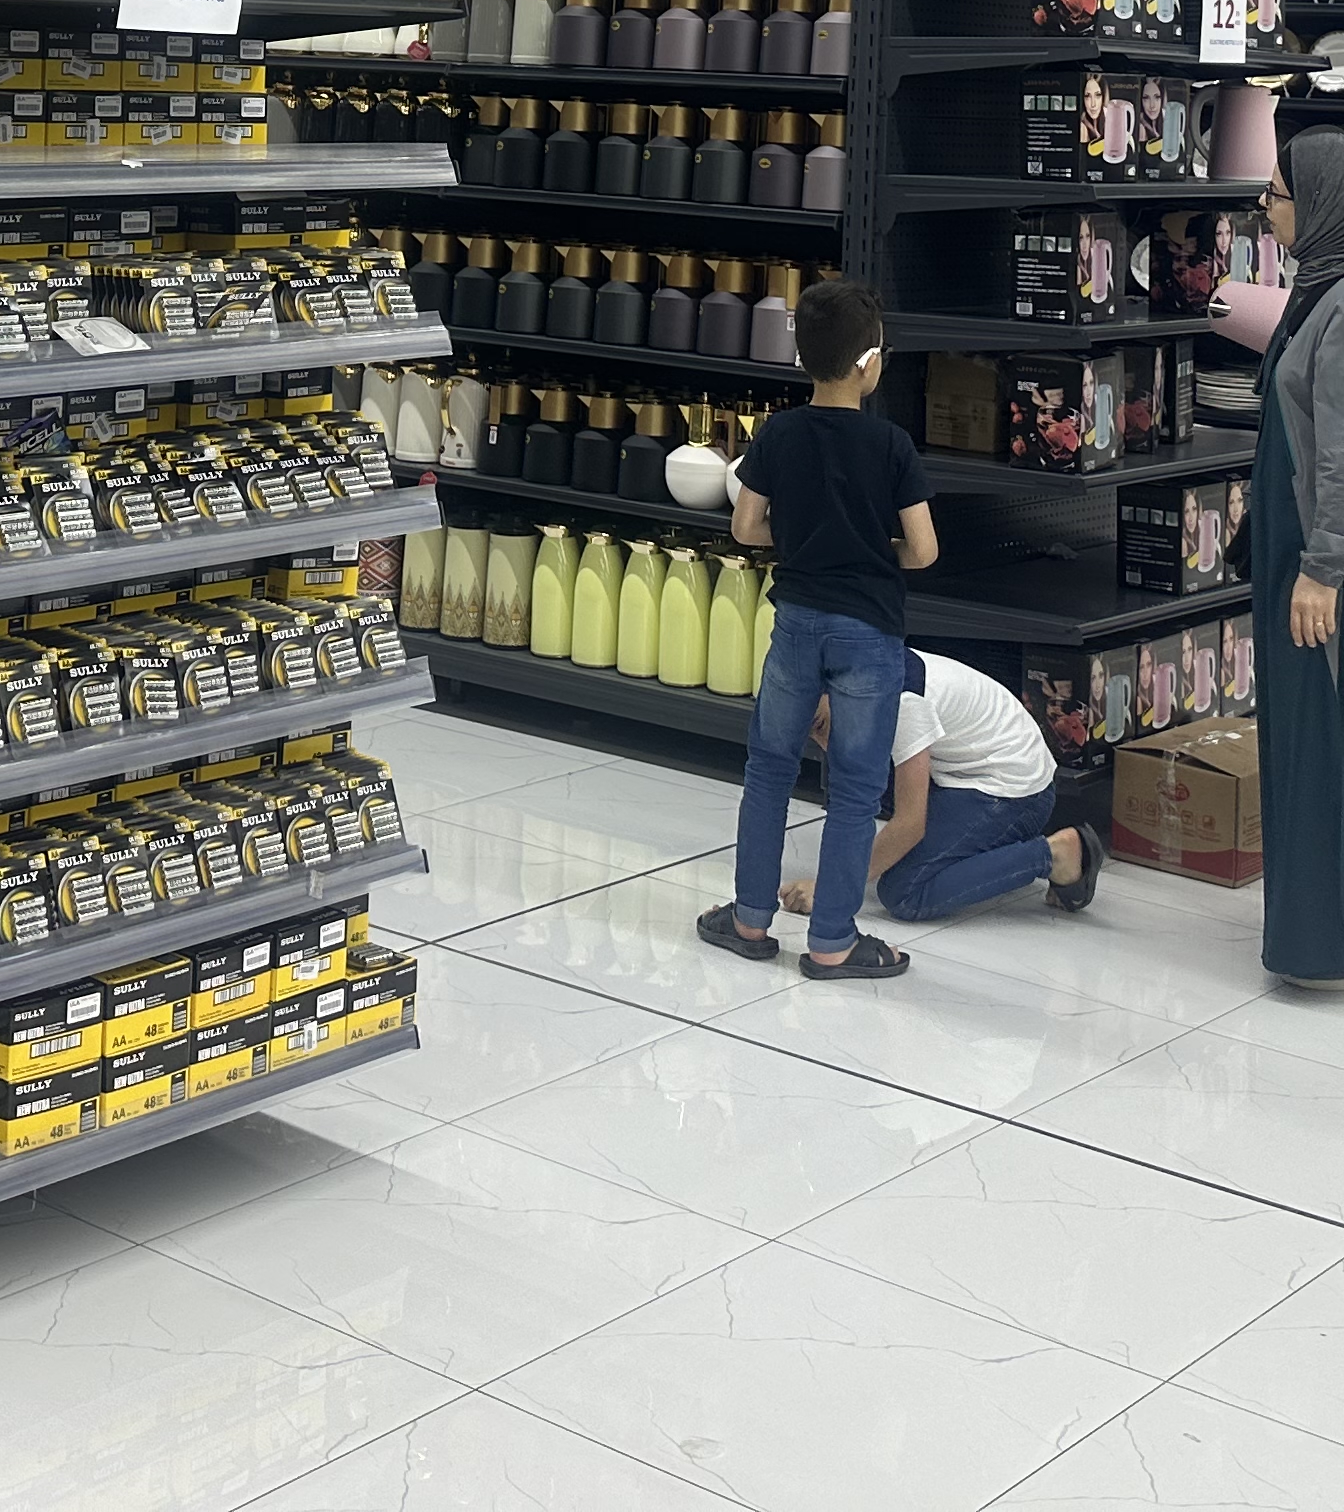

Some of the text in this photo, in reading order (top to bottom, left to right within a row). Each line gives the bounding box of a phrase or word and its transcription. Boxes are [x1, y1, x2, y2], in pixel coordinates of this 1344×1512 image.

[1213, 0, 1235, 28] 12
[240, 207, 269, 215] SULLY
[371, 268, 401, 278] SULLY
[41, 480, 82, 494] SULLY
[358, 613, 389, 626] SULLY
[113, 980, 148, 997] SULLY
